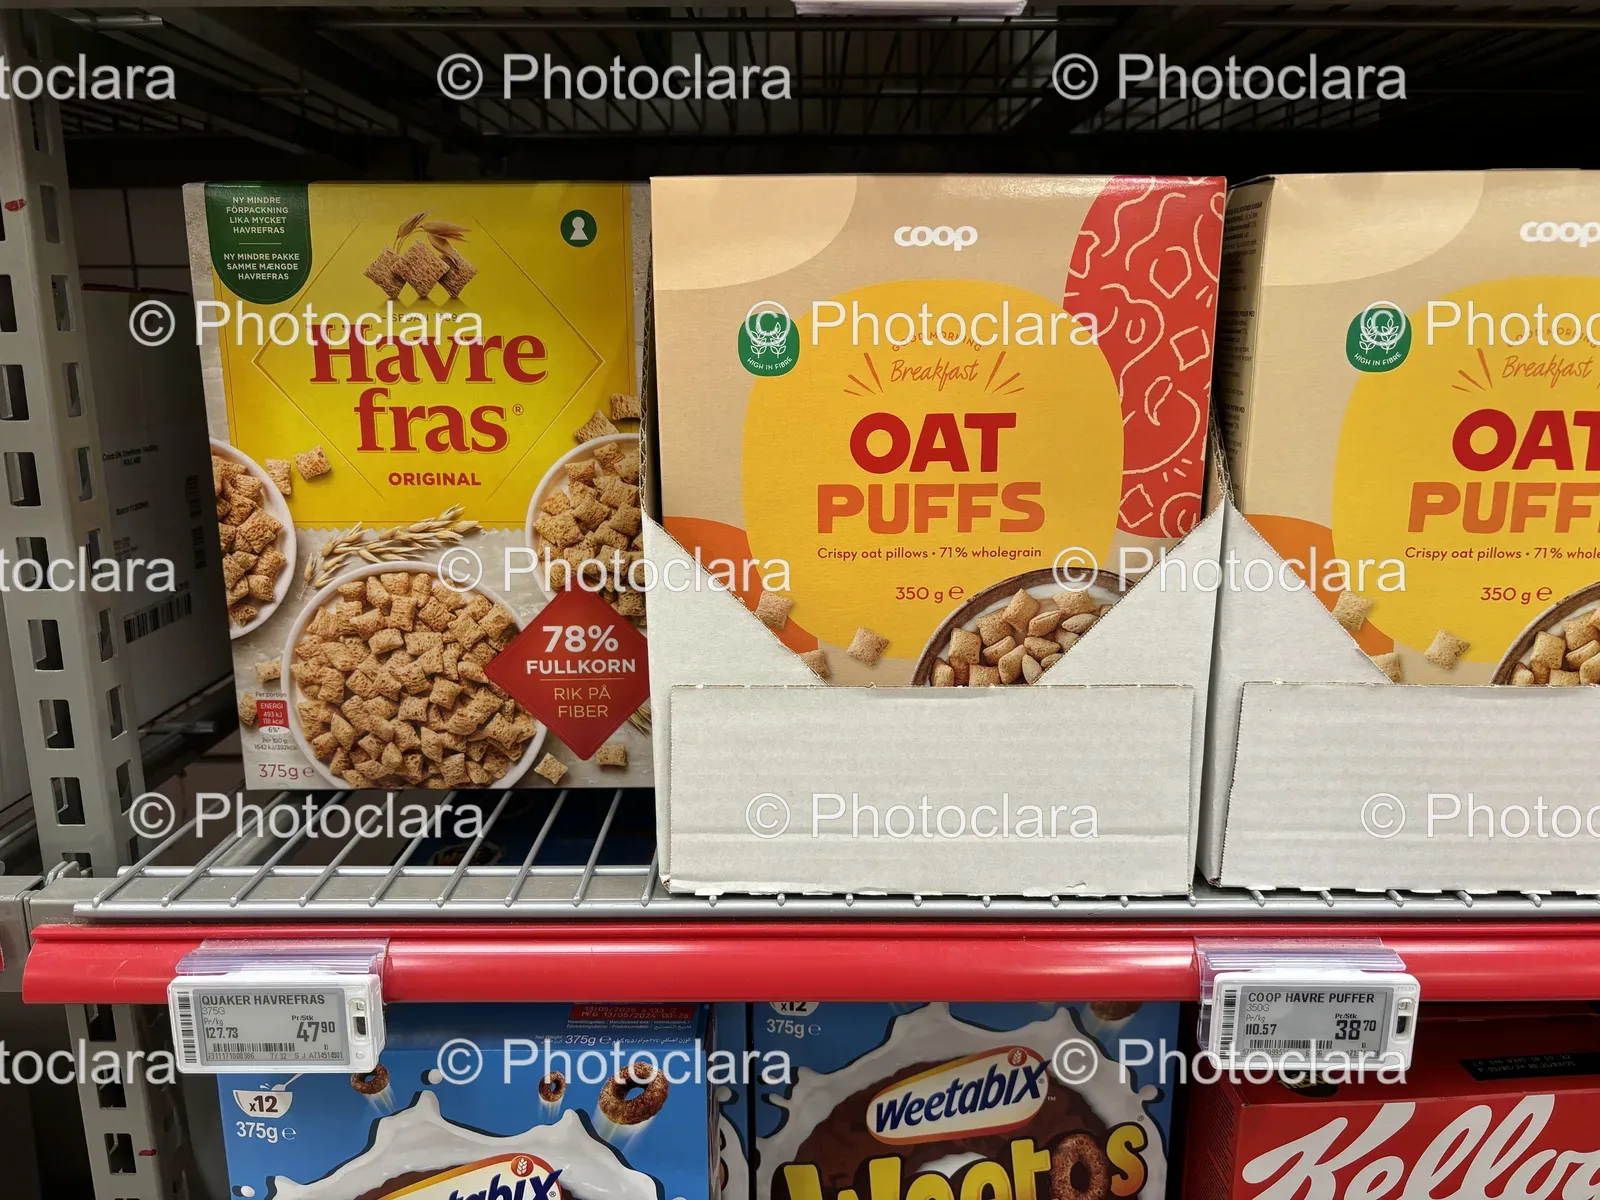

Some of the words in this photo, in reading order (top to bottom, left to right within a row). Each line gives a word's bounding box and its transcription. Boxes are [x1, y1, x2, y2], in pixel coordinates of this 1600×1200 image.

[232, 196, 245, 204] NY
[246, 196, 281, 204] MINDRE
[226, 205, 289, 214] FÖRPACKNING
[229, 216, 250, 224] LIKA
[252, 216, 287, 224] MYCKET
[233, 226, 285, 234] HAVREFRAS
[894, 226, 978, 251] coop
[223, 253, 237, 261] NY
[237, 253, 270, 261] MINDRE
[271, 253, 300, 261] PAKKE
[238, 272, 289, 280] HAVREFRAS
[305, 324, 548, 384] Havre
[1353, 352, 1371, 366] HIGH
[1382, 351, 1402, 366] FIBRE
[747, 357, 764, 370] HIGH
[774, 356, 793, 370] FIBRE
[891, 357, 979, 391] Breakfast
[1502, 354, 1593, 388] Breakfast
[850, 412, 1016, 474] OAT
[389, 472, 482, 486] ORIGINAL
[818, 482, 1045, 534] PUFFS
[1408, 481, 1600, 534] PUFF
[817, 547, 857, 561] Crispy
[861, 548, 882, 559] oat
[886, 547, 928, 561] pillows
[939, 547, 968, 558] 71%
[972, 546, 1041, 560] wholegrain
[1405, 547, 1448, 562] Crispy
[1451, 548, 1474, 559] oat
[1477, 547, 1522, 561] pillows
[1533, 547, 1562, 558] 71%
[896, 587, 929, 600] 350
[1480, 587, 1516, 600] 350
[543, 625, 619, 652] 78%
[526, 659, 635, 674] FULLKORN
[554, 687, 582, 700] RIK
[588, 685, 611, 700] PÅ
[558, 705, 608, 718] FIBER
[258, 764, 299, 780] 375g
[201, 995, 251, 1006] QUAKER
[254, 994, 325, 1005] HAVREFRAS
[1248, 992, 1281, 1003] COOP
[1285, 992, 1325, 1003] HAVRE
[1329, 993, 1375, 1003] PUFFER
[202, 1007, 226, 1015] 375G
[1246, 1004, 1270, 1012] 350G
[204, 1018, 224, 1026] Pr/kg
[1246, 1014, 1265, 1023] Pr/kg
[206, 1027, 239, 1039] 127.73
[296, 1022, 320, 1042] 47
[766, 1019, 805, 1039] 375g
[1245, 1023, 1277, 1035] 110.57
[1335, 1019, 1361, 1040] 38
[565, 1034, 596, 1046] 375g
[249, 1095, 279, 1113] x12
[236, 1121, 278, 1143] 375g
[1242, 1094, 1600, 1200] Kello
